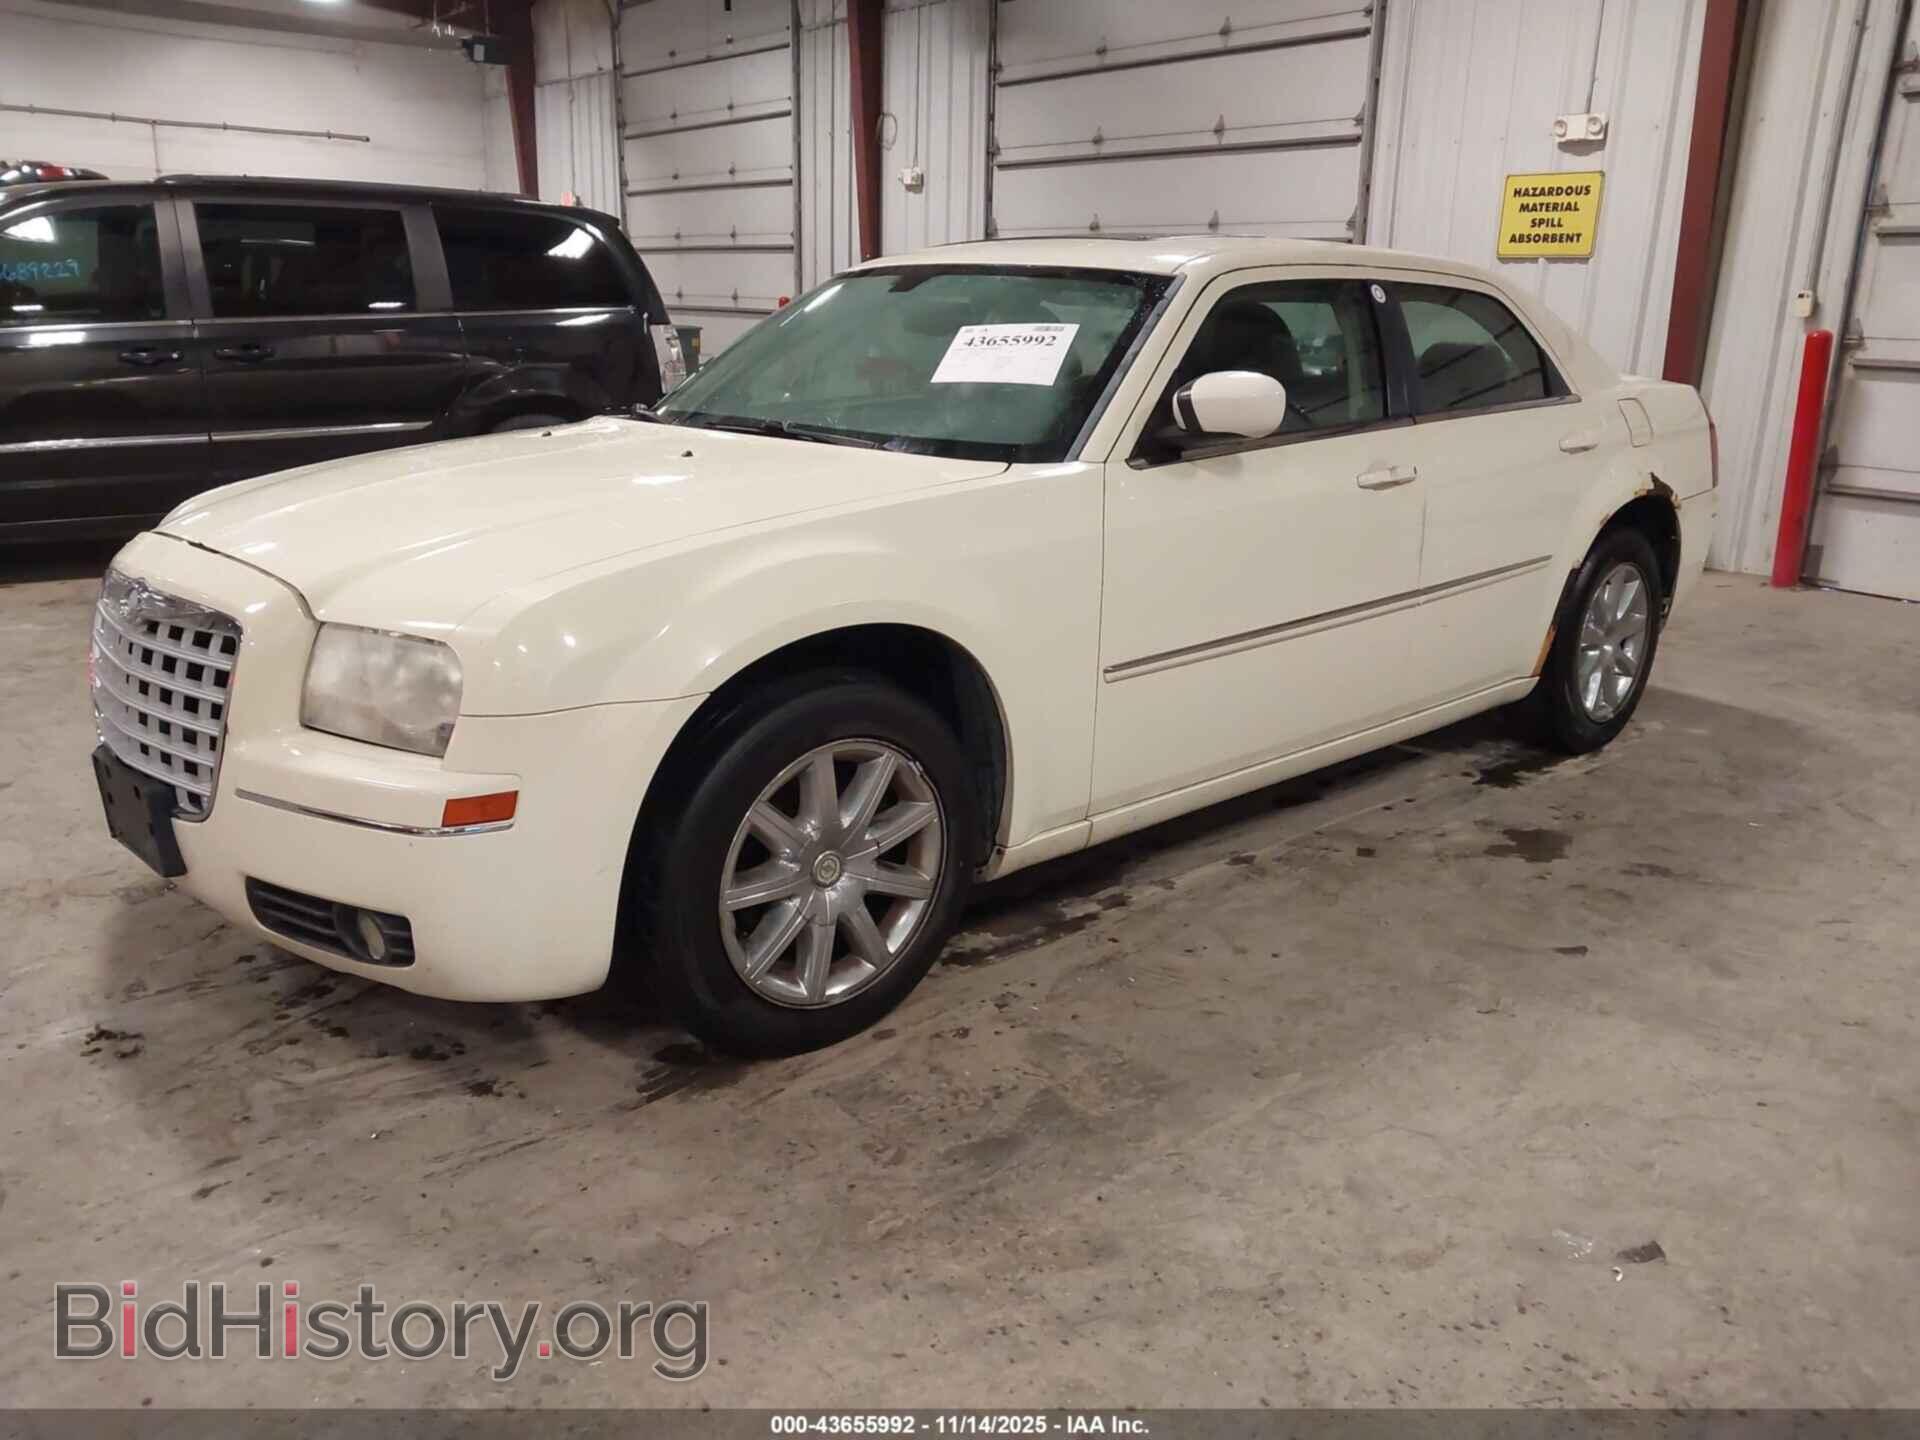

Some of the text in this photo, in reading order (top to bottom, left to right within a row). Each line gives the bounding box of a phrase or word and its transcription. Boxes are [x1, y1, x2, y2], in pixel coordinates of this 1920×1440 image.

[1513, 185, 1591, 197] HAZARDOUS
[1519, 201, 1580, 212] MATERIAL
[1530, 217, 1563, 228] SPILL
[1509, 233, 1582, 243] ABSORBENT
[964, 335, 1057, 347] 43655992
